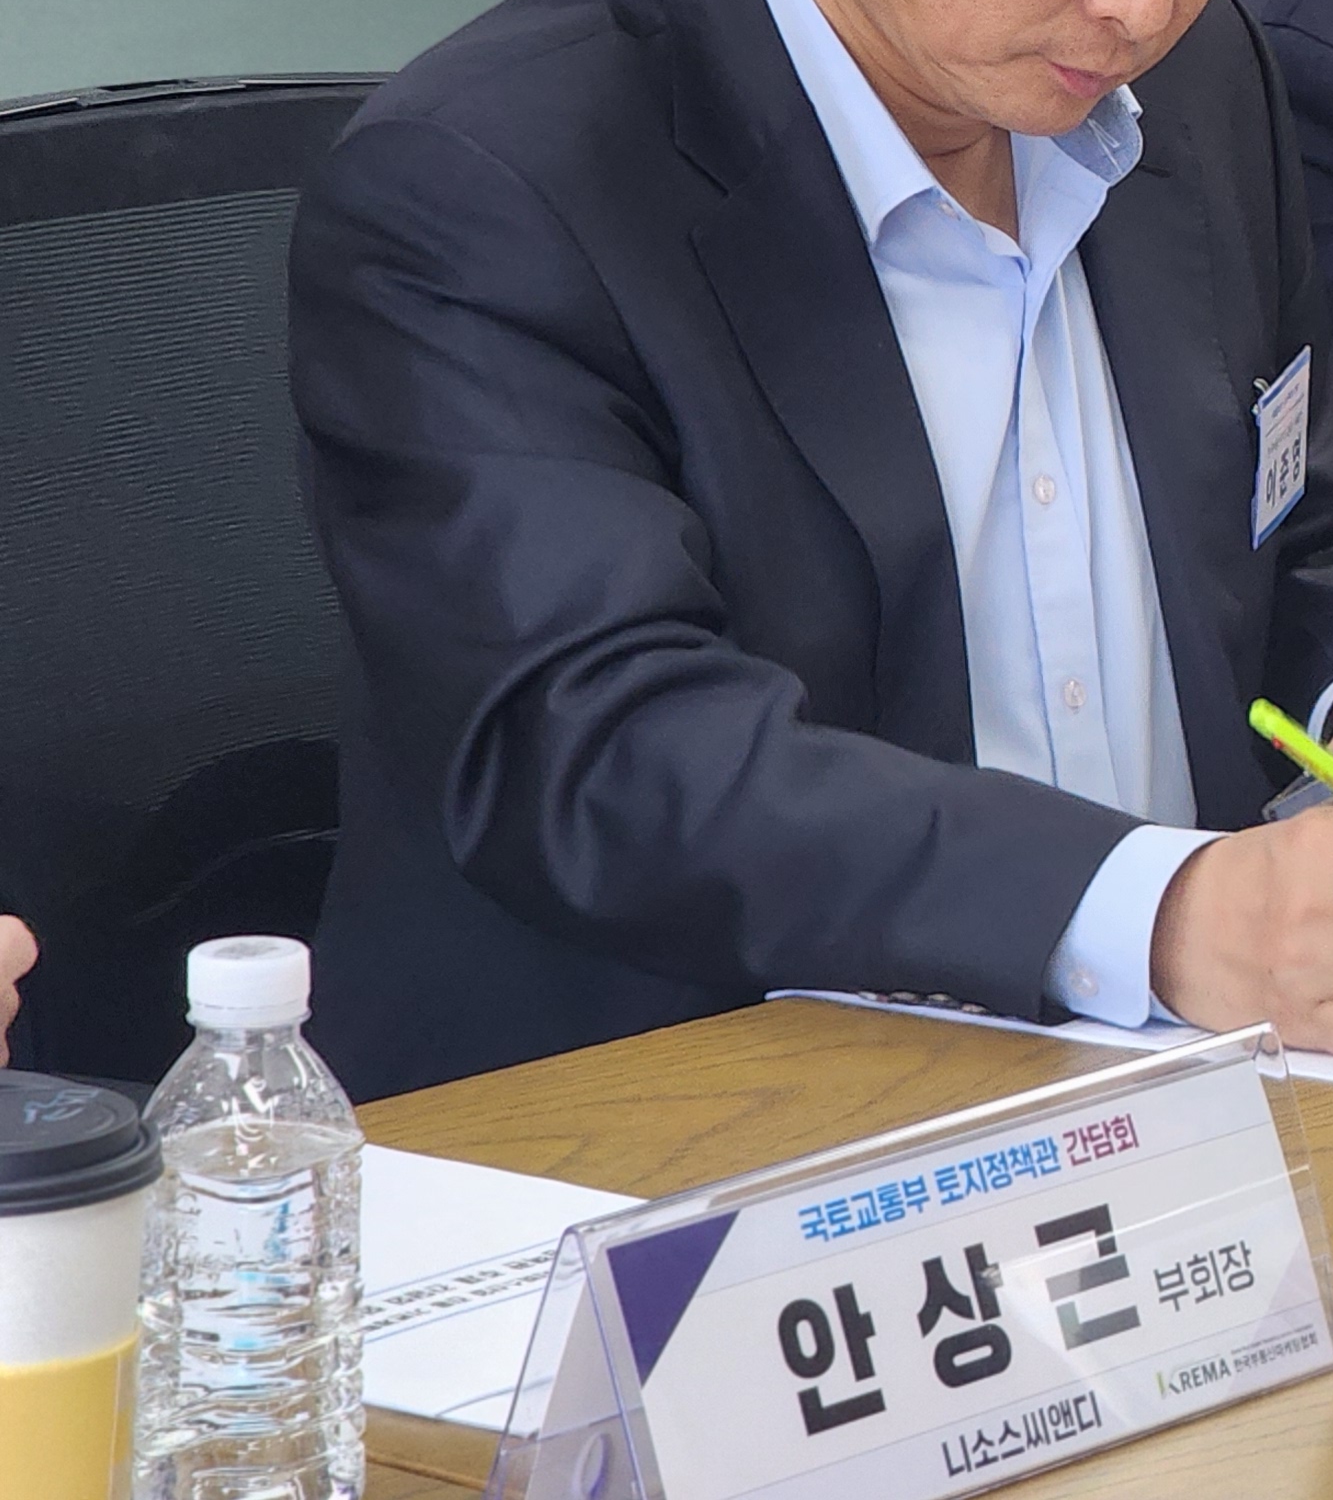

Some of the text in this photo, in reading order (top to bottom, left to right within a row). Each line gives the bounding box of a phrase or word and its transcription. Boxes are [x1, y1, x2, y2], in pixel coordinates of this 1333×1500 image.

[798, 1114, 1141, 1242] 국토교통부 토지정책관 간담회
[1153, 1241, 1257, 1315] 부회장
[943, 1390, 1103, 1479] 니소스씨앤디
